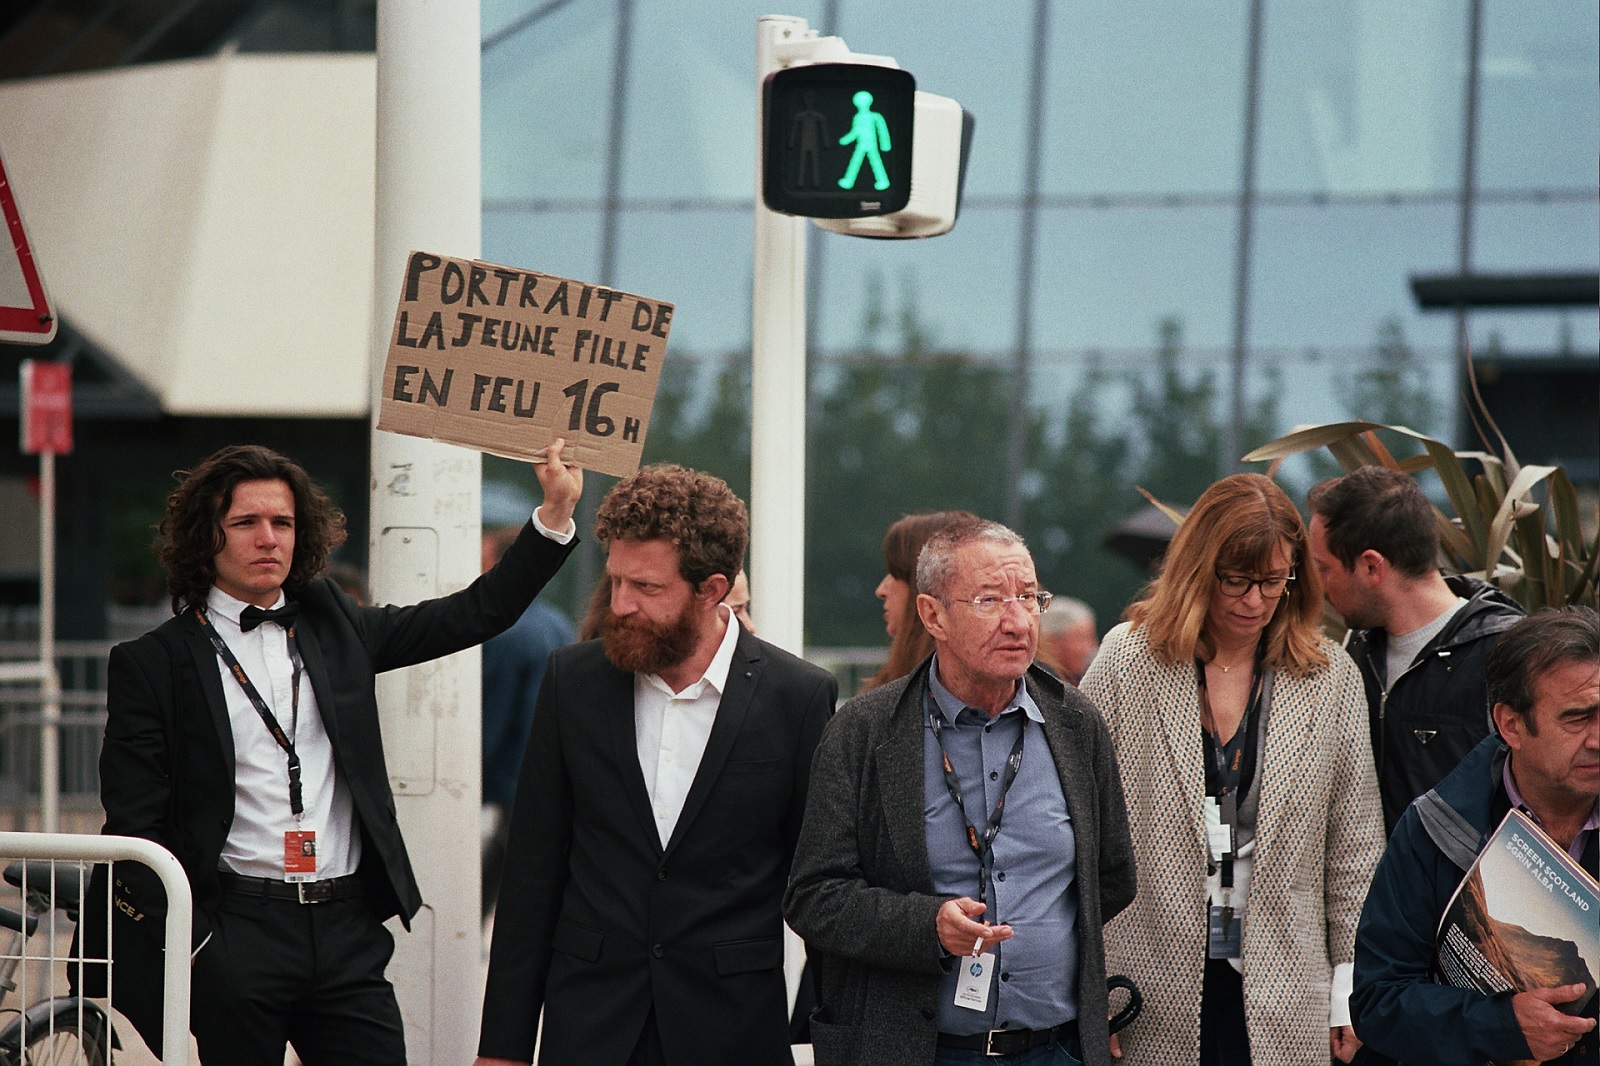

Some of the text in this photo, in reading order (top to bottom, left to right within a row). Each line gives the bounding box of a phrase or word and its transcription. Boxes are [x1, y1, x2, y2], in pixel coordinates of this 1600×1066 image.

[405, 252, 674, 338] PORTRAIT DE
[573, 329, 650, 372] FILLE
[393, 365, 453, 407] EN
[471, 372, 541, 419] FEU
[1511, 833, 1589, 911] SCREEN SCOTLAND
[1531, 868, 1553, 893] ALBA
